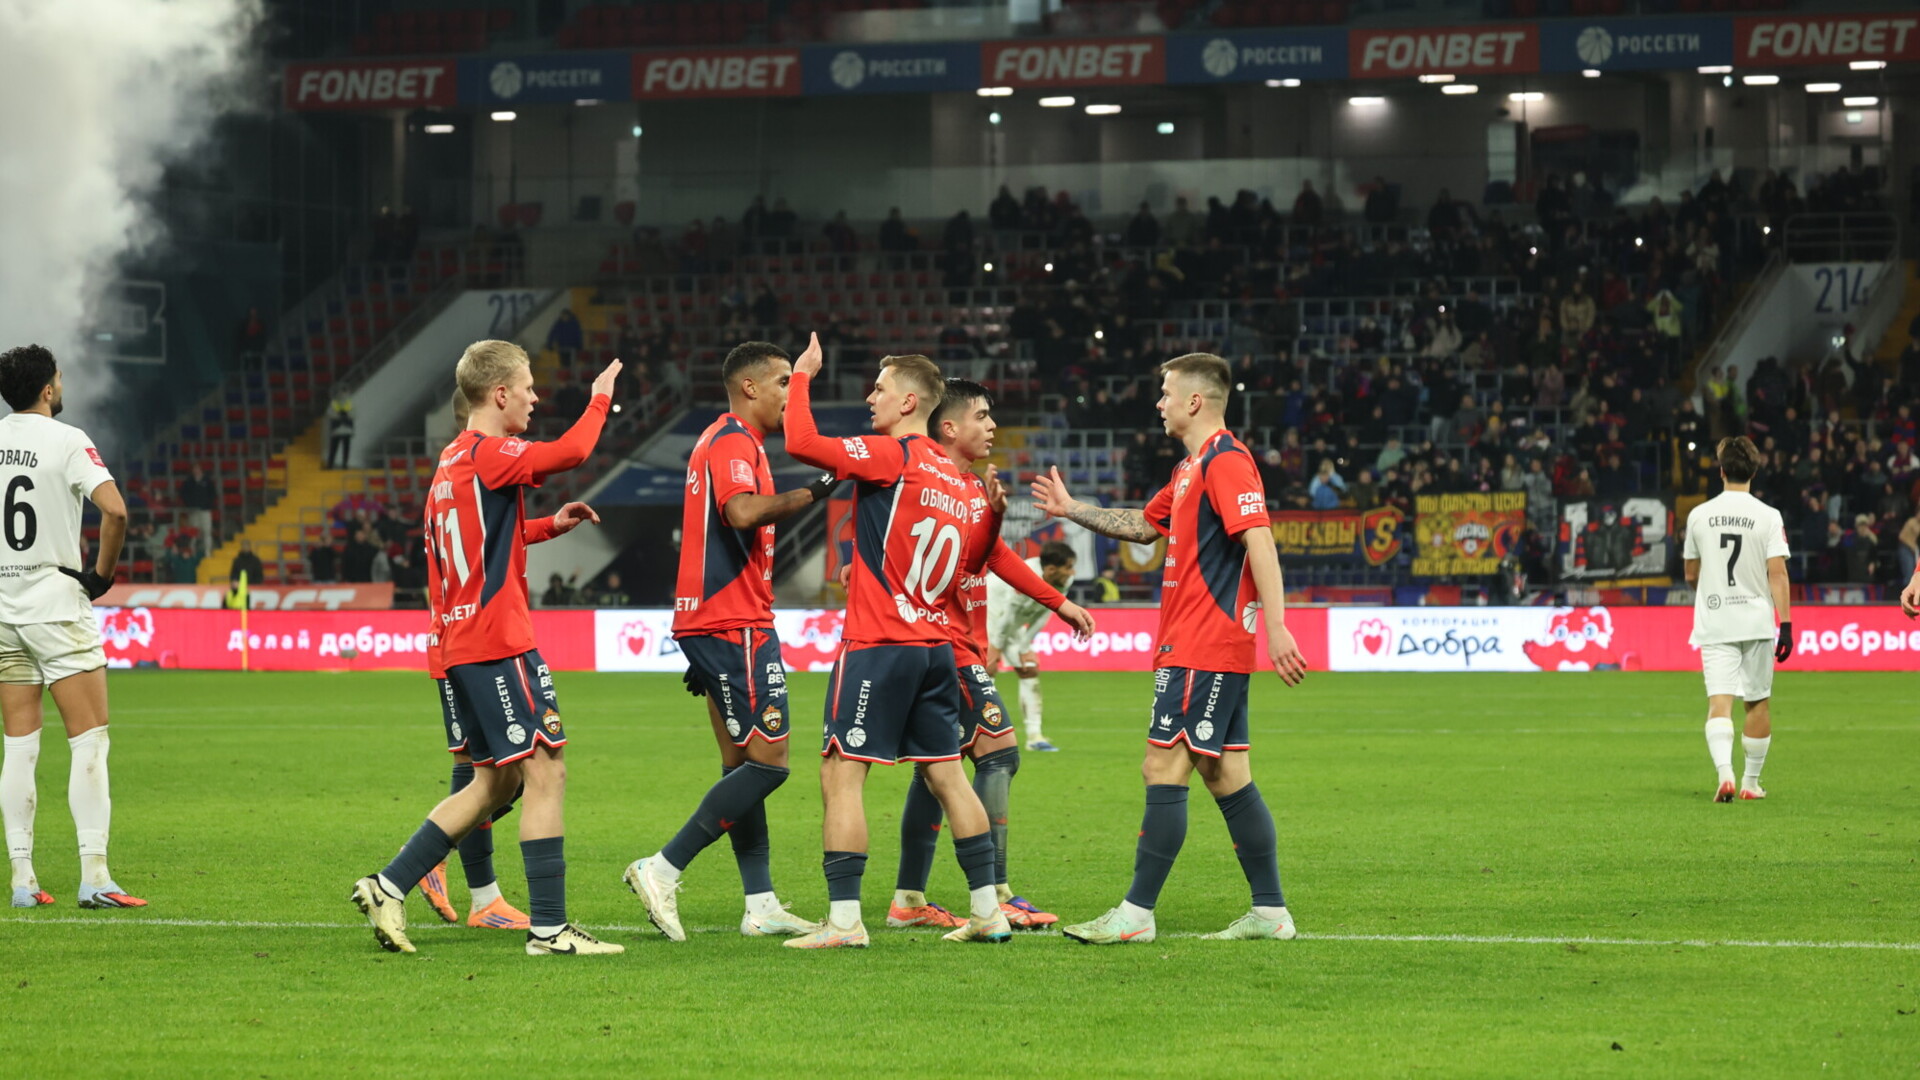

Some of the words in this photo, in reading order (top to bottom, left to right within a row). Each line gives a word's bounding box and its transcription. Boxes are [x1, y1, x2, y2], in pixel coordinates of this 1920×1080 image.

[1242, 46, 1322, 65] РОССЕТИ
[1362, 32, 1525, 70] FONBET
[1618, 34, 1700, 54] РОССЕТИ
[1748, 19, 1917, 58] FONBET
[526, 68, 601, 88] РОССЕТИ
[643, 55, 797, 91] FONBET
[868, 58, 947, 77] РОССЕТИ
[993, 44, 1152, 81] FONBET
[298, 67, 444, 102] FONBET
[842, 438, 860, 461] BET
[851, 437, 871, 459] FON
[4, 475, 37, 552] 6
[921, 487, 968, 524] ОБЛЯКОВ
[1237, 492, 1262, 505] FON
[1240, 502, 1264, 516] BET
[1274, 520, 1356, 546] МОСКВЫ
[1708, 515, 1756, 530] СЕВИКЯН
[910, 516, 962, 605] 10
[1719, 533, 1743, 587] 7
[226, 629, 311, 652] Делай
[1031, 630, 1152, 657] добрые
[1397, 628, 1503, 667] Добра
[1798, 622, 1920, 657] добрые
[494, 675, 516, 723] РОССЕТИ
[718, 673, 735, 717] РОССЕТИ
[854, 679, 872, 726] РОССЕТИ
[1204, 673, 1225, 719] РОССЕТИ
